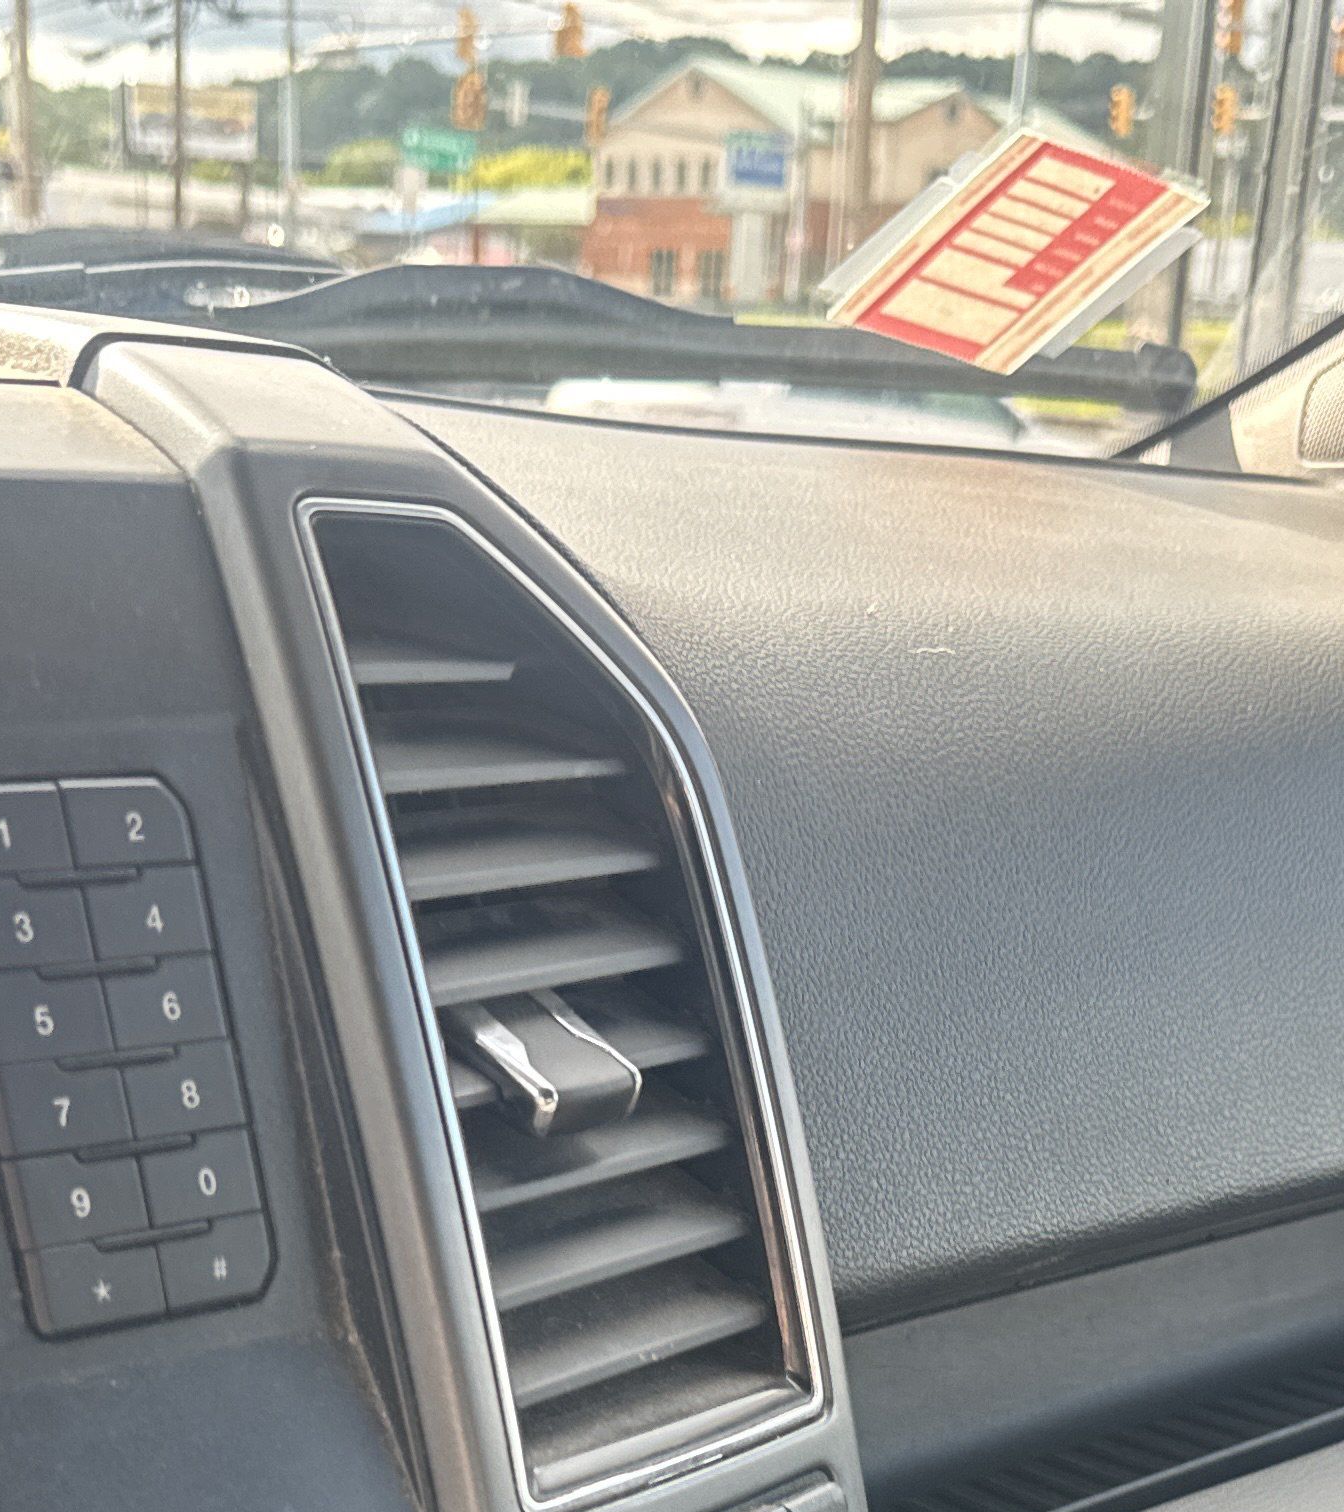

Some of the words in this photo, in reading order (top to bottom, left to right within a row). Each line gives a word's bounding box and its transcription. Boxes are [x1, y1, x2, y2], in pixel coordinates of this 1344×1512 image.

[124, 810, 146, 843] 2
[12, 910, 35, 944] 3
[145, 903, 165, 934] 4
[33, 1004, 56, 1037] 5
[161, 990, 183, 1022] 6
[52, 1095, 72, 1128] 7
[179, 1078, 202, 1110] 8
[69, 1186, 92, 1219] 9
[197, 1166, 218, 1197] 0
